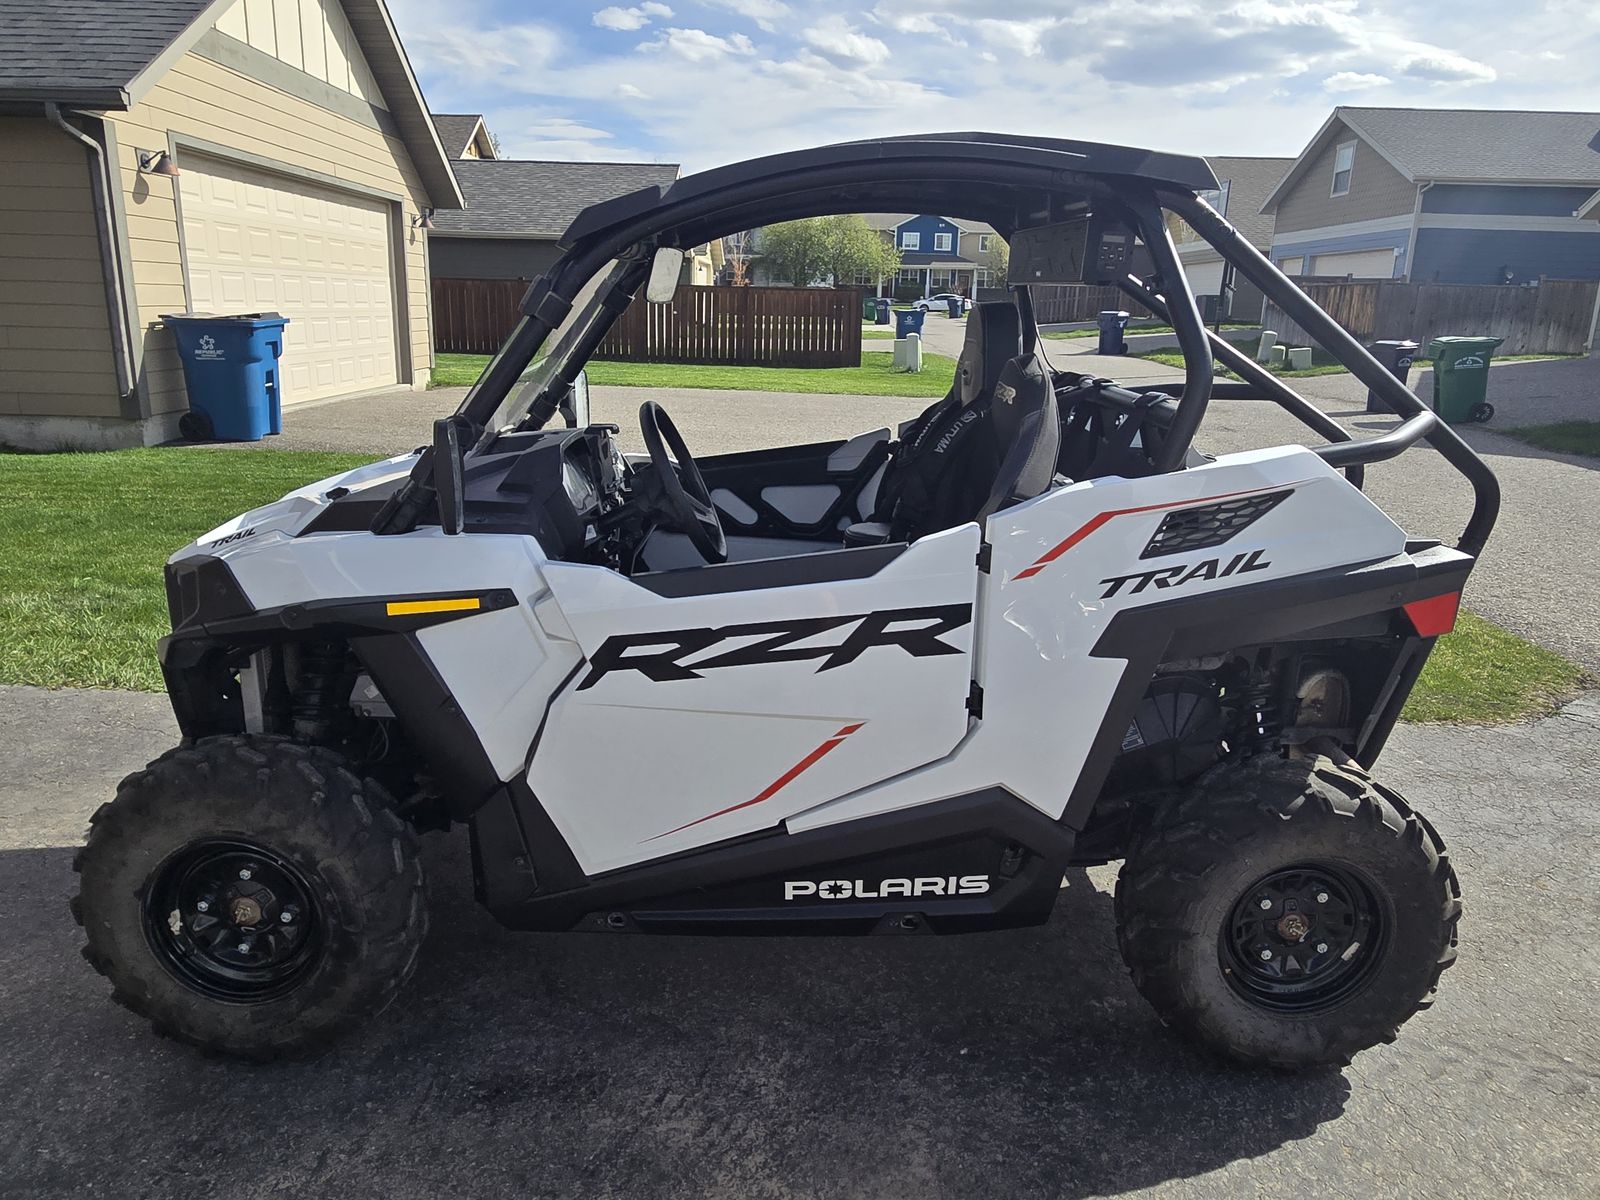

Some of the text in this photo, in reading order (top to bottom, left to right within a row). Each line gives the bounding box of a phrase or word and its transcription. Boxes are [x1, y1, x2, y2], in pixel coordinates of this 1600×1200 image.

[211, 528, 256, 548] TRAIL
[1098, 548, 1272, 600] TRAIL
[575, 602, 973, 692] RZR
[784, 874, 990, 901] POLARIS
